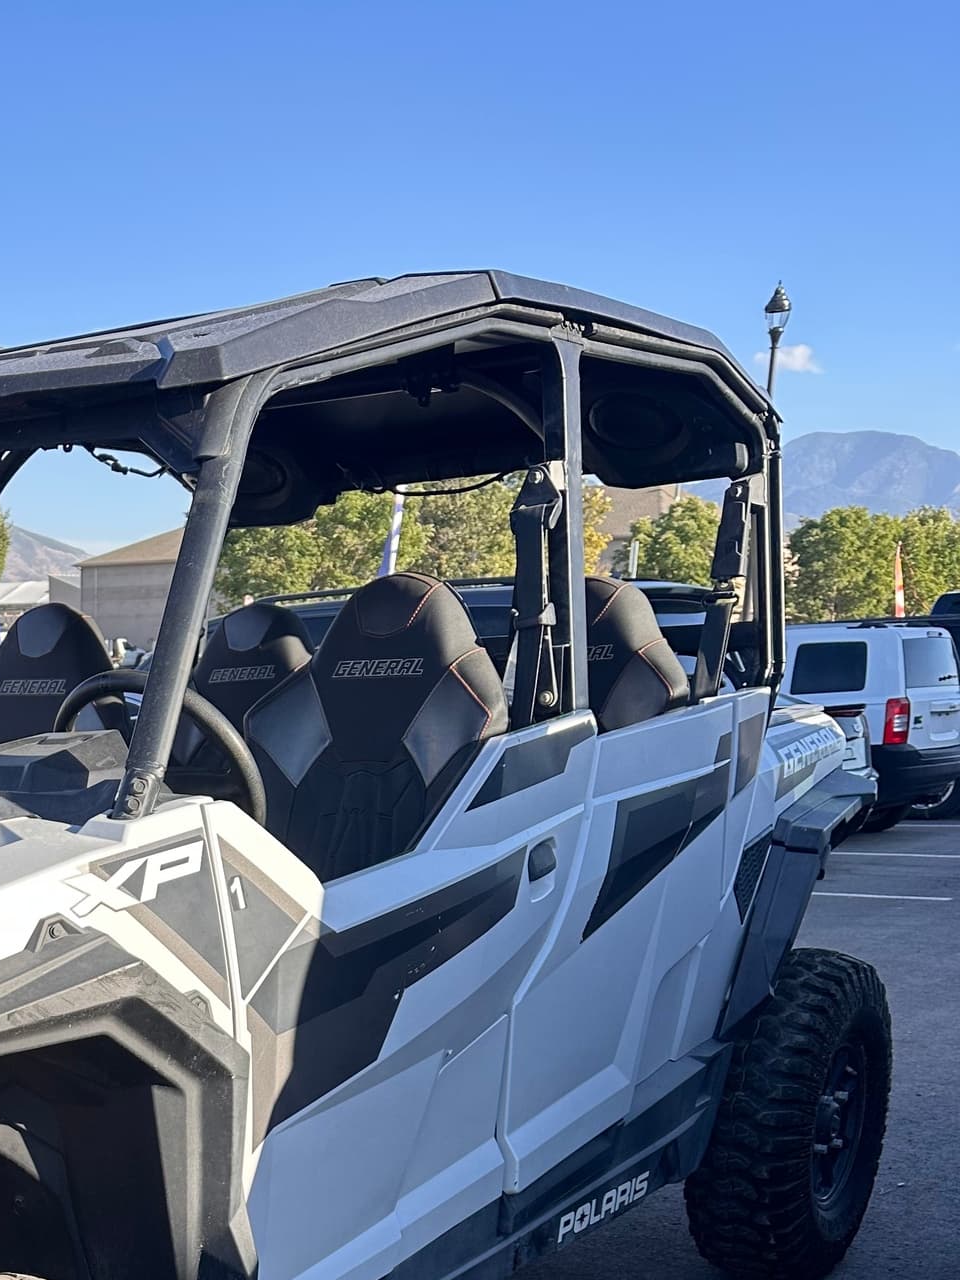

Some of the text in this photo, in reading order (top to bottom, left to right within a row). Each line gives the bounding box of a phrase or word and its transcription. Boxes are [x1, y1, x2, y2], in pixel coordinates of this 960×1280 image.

[208, 665, 276, 684] GENERAL
[332, 658, 424, 678] GENERAL
[63, 840, 204, 917] XP
[230, 876, 247, 911] 1
[557, 1170, 650, 1244] POLARIS
